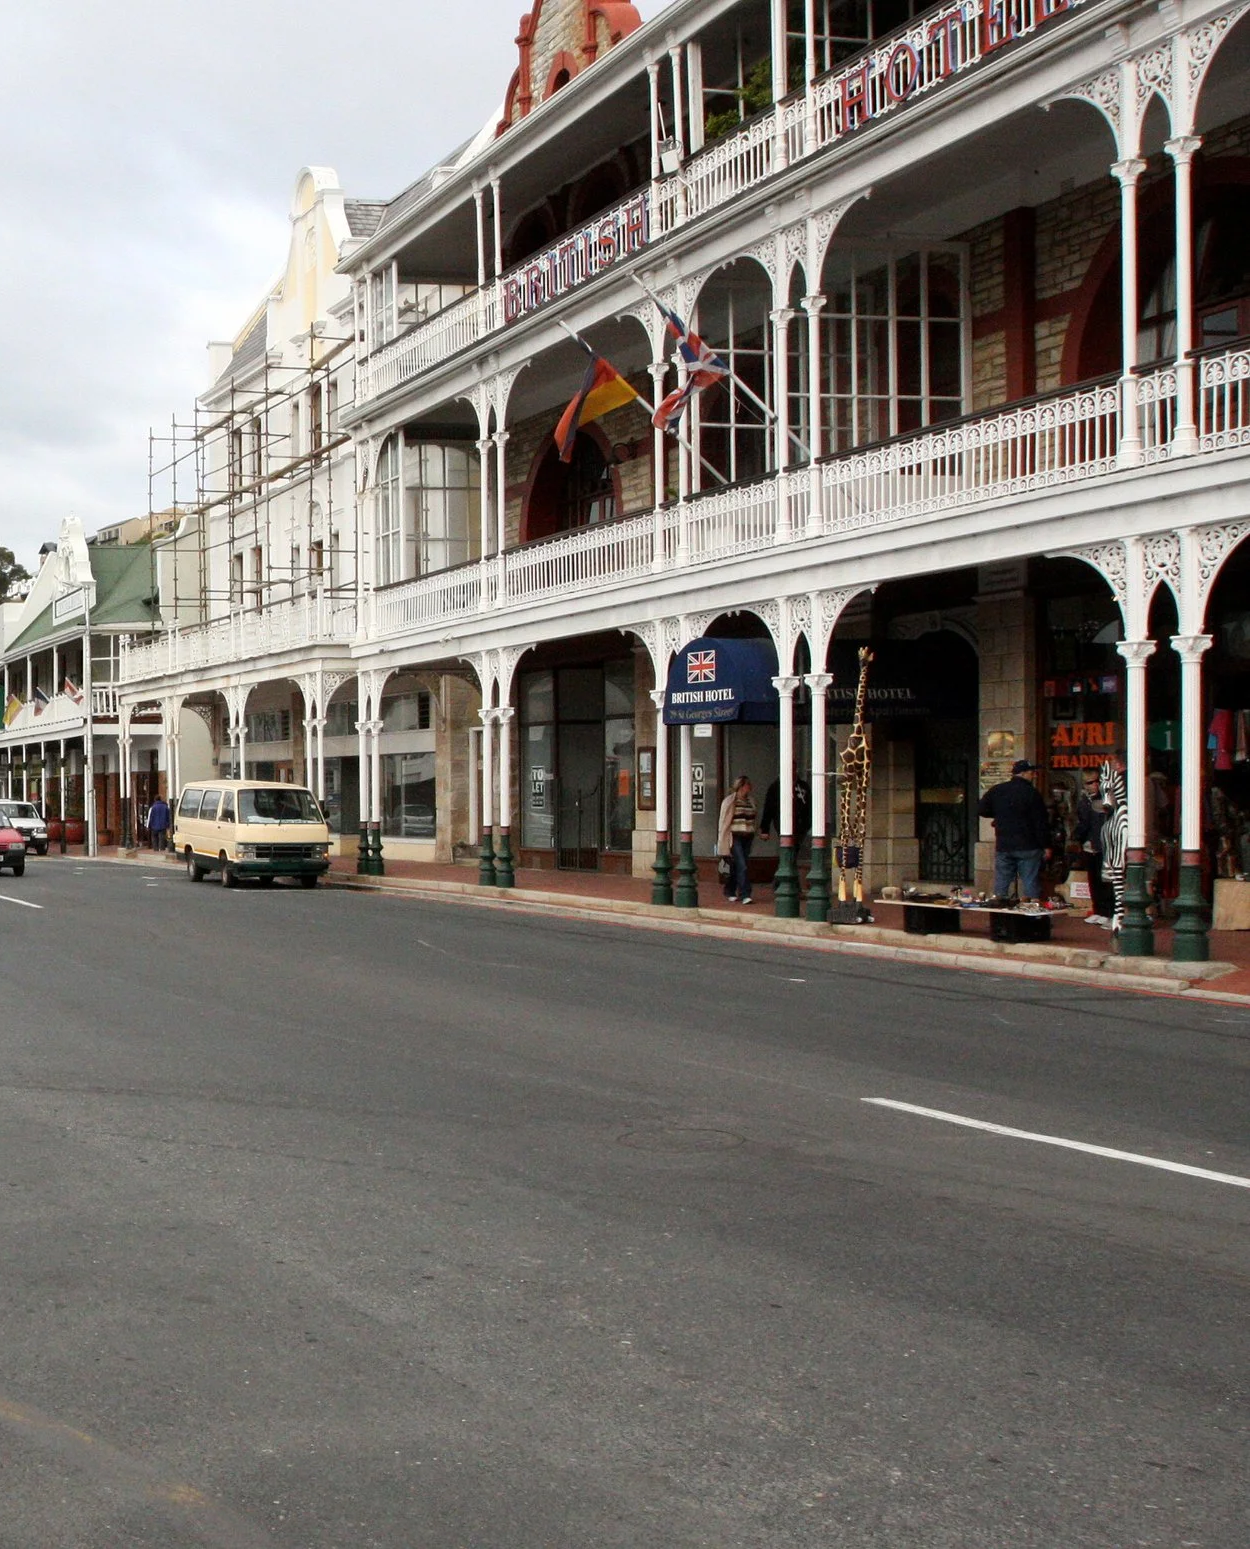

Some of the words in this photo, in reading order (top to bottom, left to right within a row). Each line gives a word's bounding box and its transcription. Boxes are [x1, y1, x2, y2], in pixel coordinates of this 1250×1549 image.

[503, 194, 649, 324] BRITISH
[671, 690, 704, 704] BRITISH
[705, 688, 735, 702] HOTEL
[1052, 721, 1116, 747] AFRI
[532, 769, 543, 781] TO
[692, 781, 704, 796] ET
